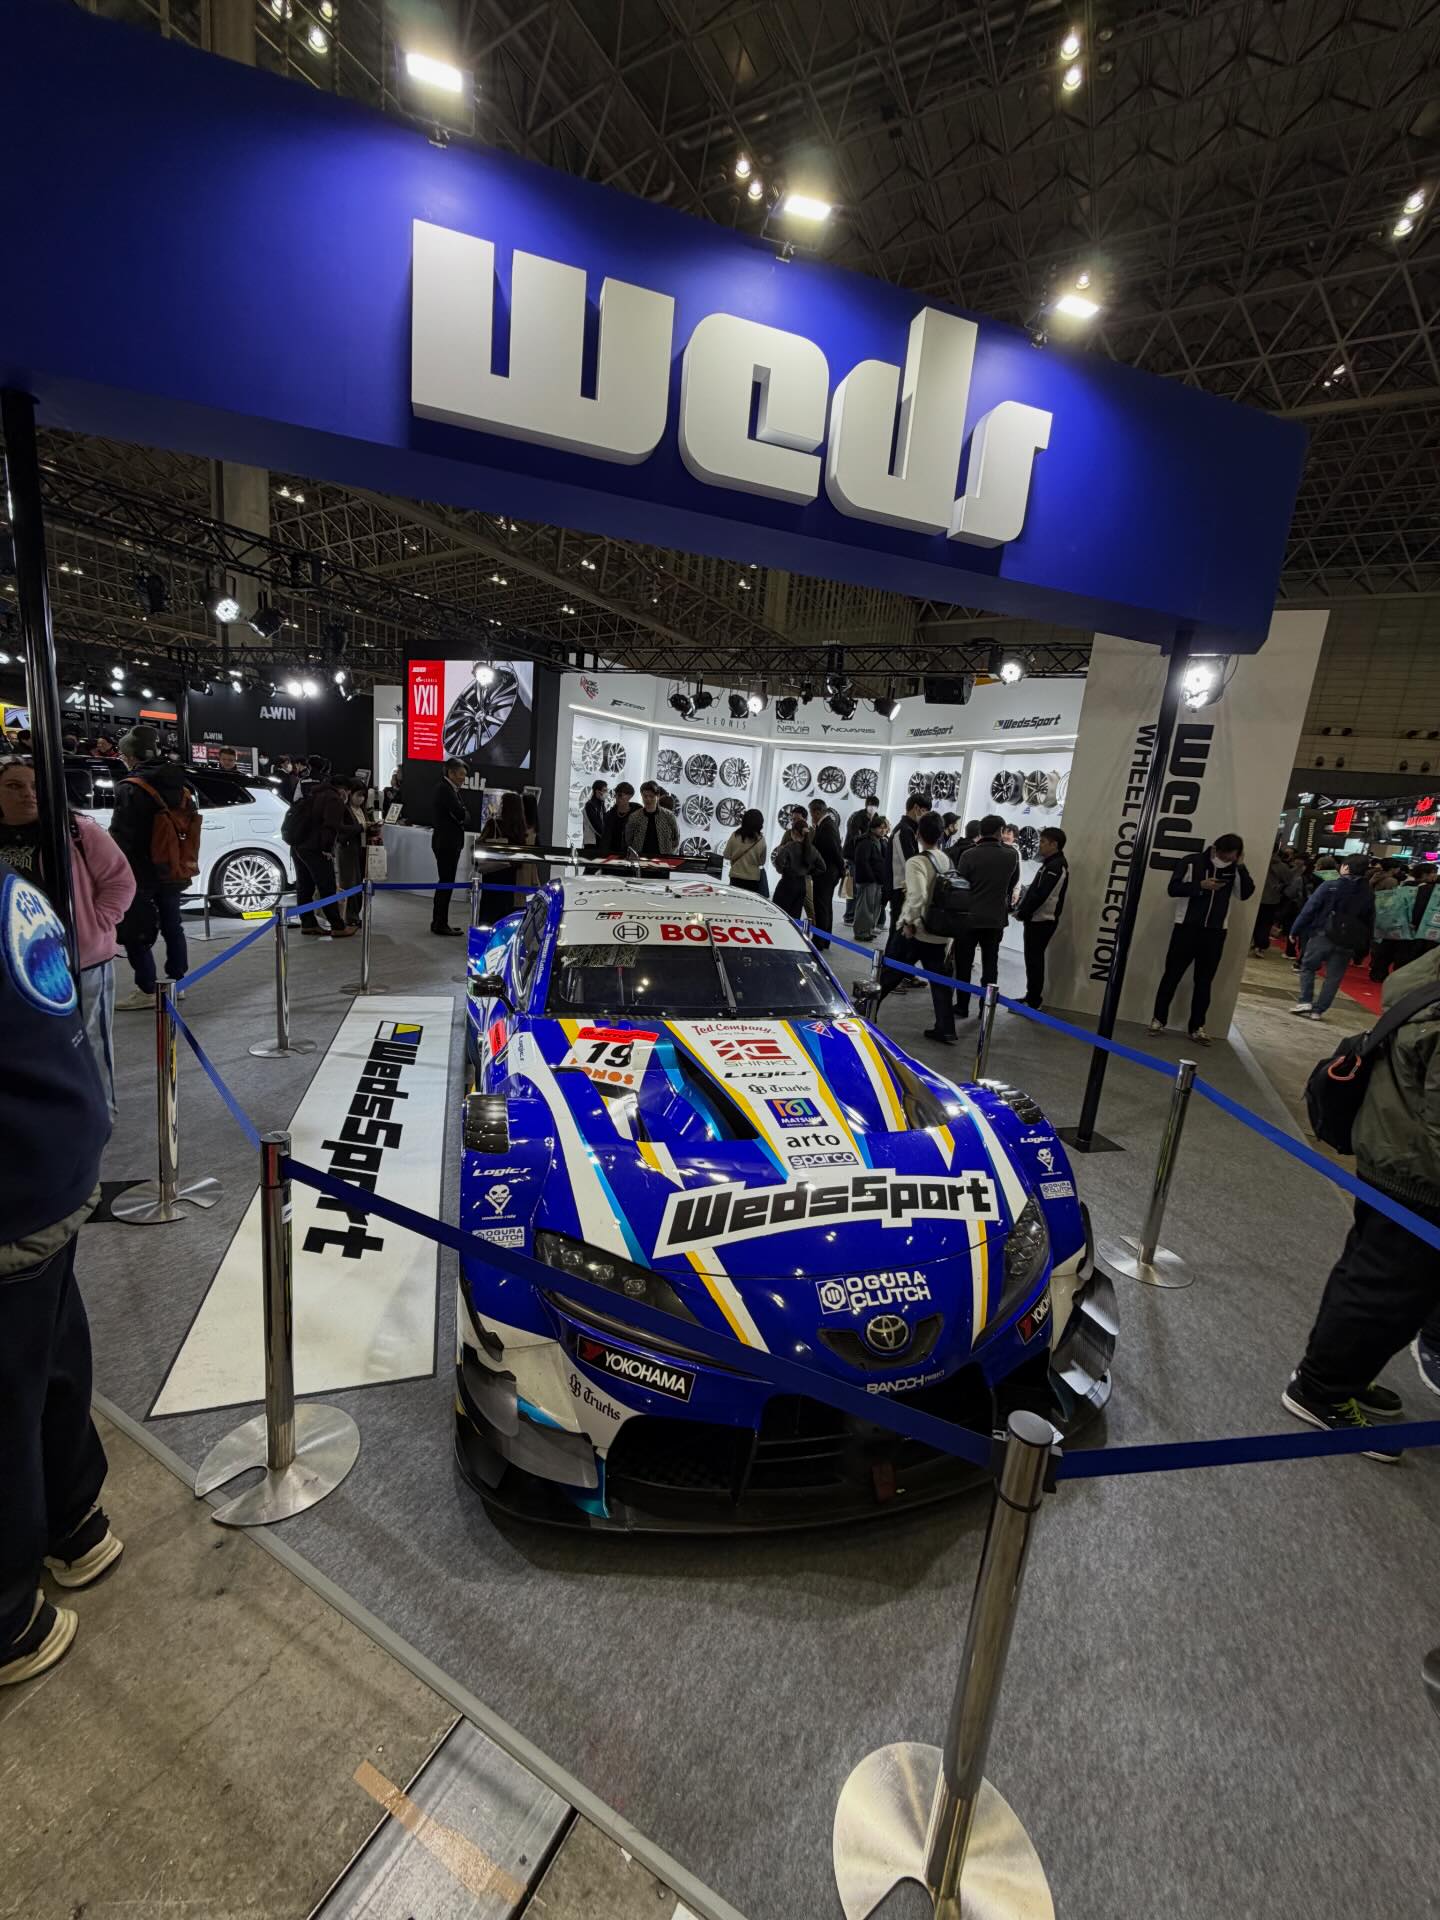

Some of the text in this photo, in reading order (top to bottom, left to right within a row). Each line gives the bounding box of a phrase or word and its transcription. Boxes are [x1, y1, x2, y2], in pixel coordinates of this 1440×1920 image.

[705, 715, 748, 730] LEONIS
[1001, 713, 1062, 731] WedsSport
[1121, 723, 1157, 817] WHEEL
[1089, 821, 1138, 982] COLLECTION
[734, 917, 774, 928] Racing
[660, 923, 774, 945] BOSCH
[691, 1023, 773, 1036] Ted Company
[586, 1041, 634, 1068] 19
[724, 1060, 798, 1068] SHINKO
[769, 1083, 812, 1094] Trucks
[785, 1132, 841, 1149] arto
[790, 1152, 854, 1168] sparco
[666, 1176, 992, 1246] WedsSport
[485, 1228, 523, 1237] OGURA
[847, 1270, 927, 1293] OGURA
[850, 1285, 932, 1309] CLUTCH
[604, 1351, 687, 1394] YOKOHAMA
[583, 1387, 621, 1421] Trucks
